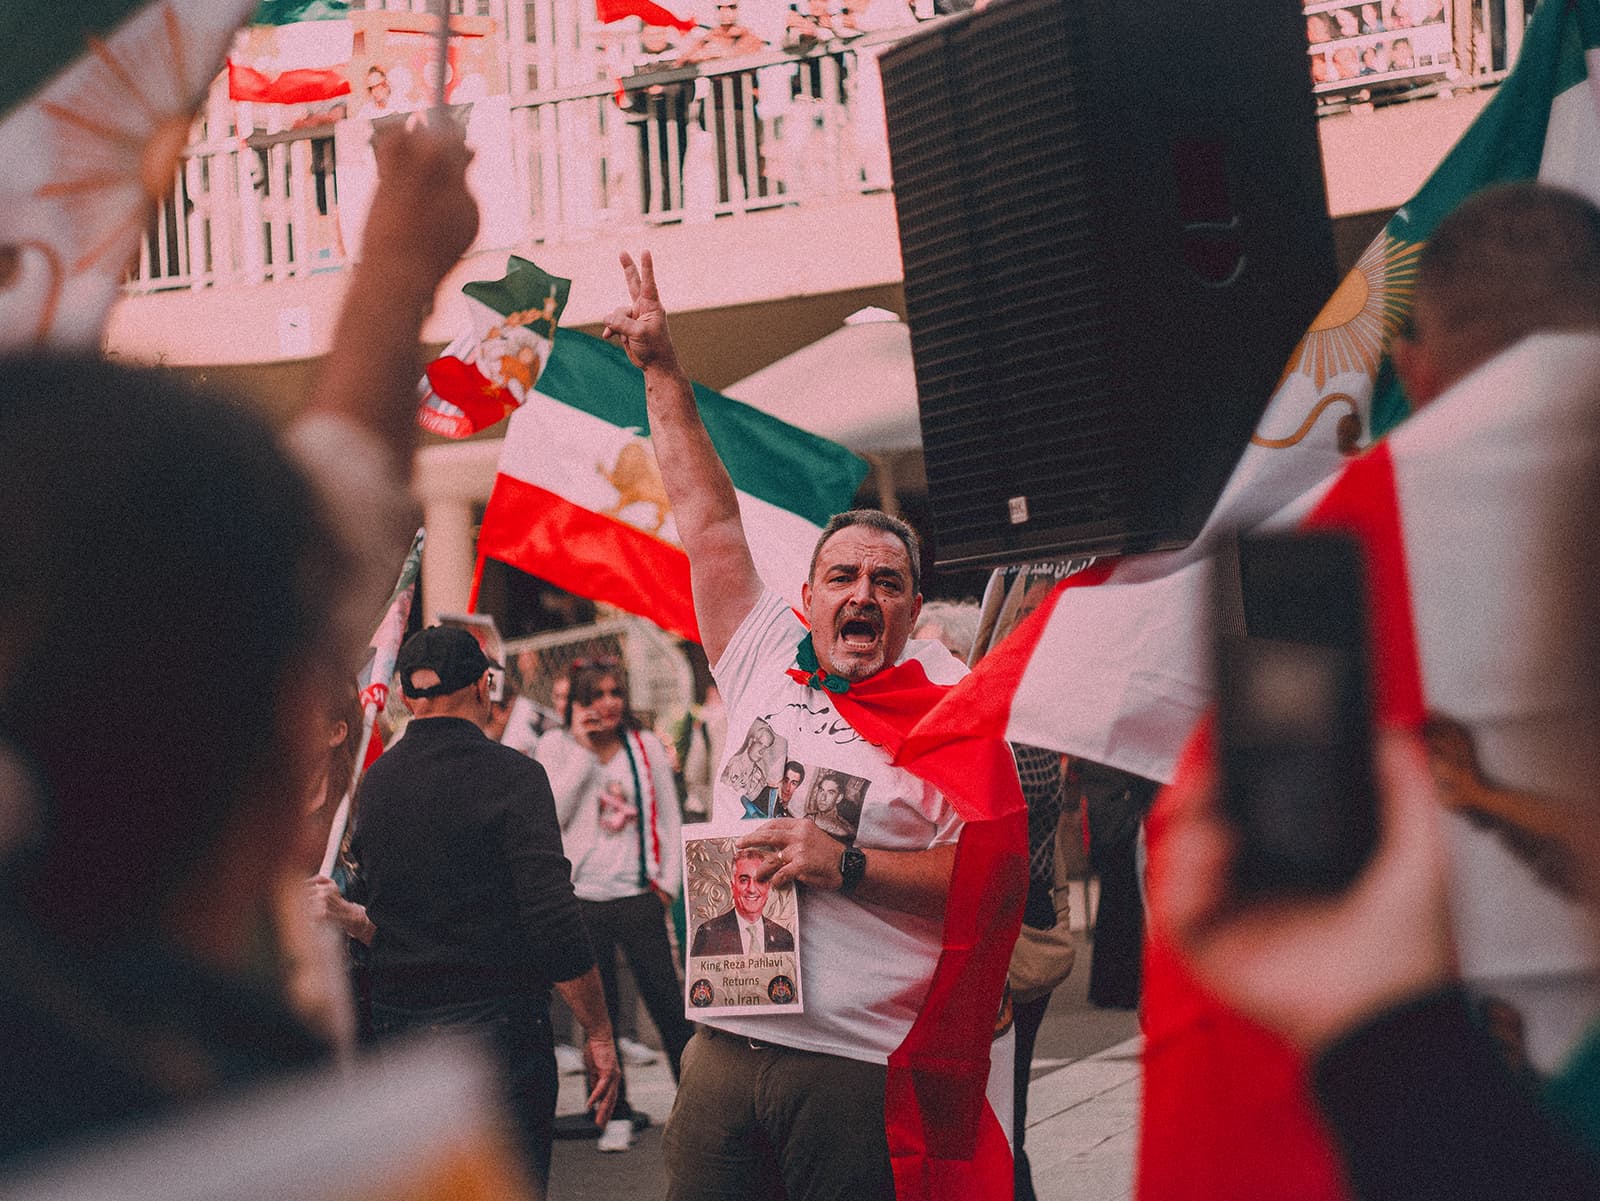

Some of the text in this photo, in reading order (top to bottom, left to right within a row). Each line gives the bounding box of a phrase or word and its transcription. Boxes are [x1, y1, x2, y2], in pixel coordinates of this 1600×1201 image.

[700, 957, 783, 972] King Reza Pahlavi
[722, 976, 759, 986] Returns
[724, 994, 760, 1006] to Iran
